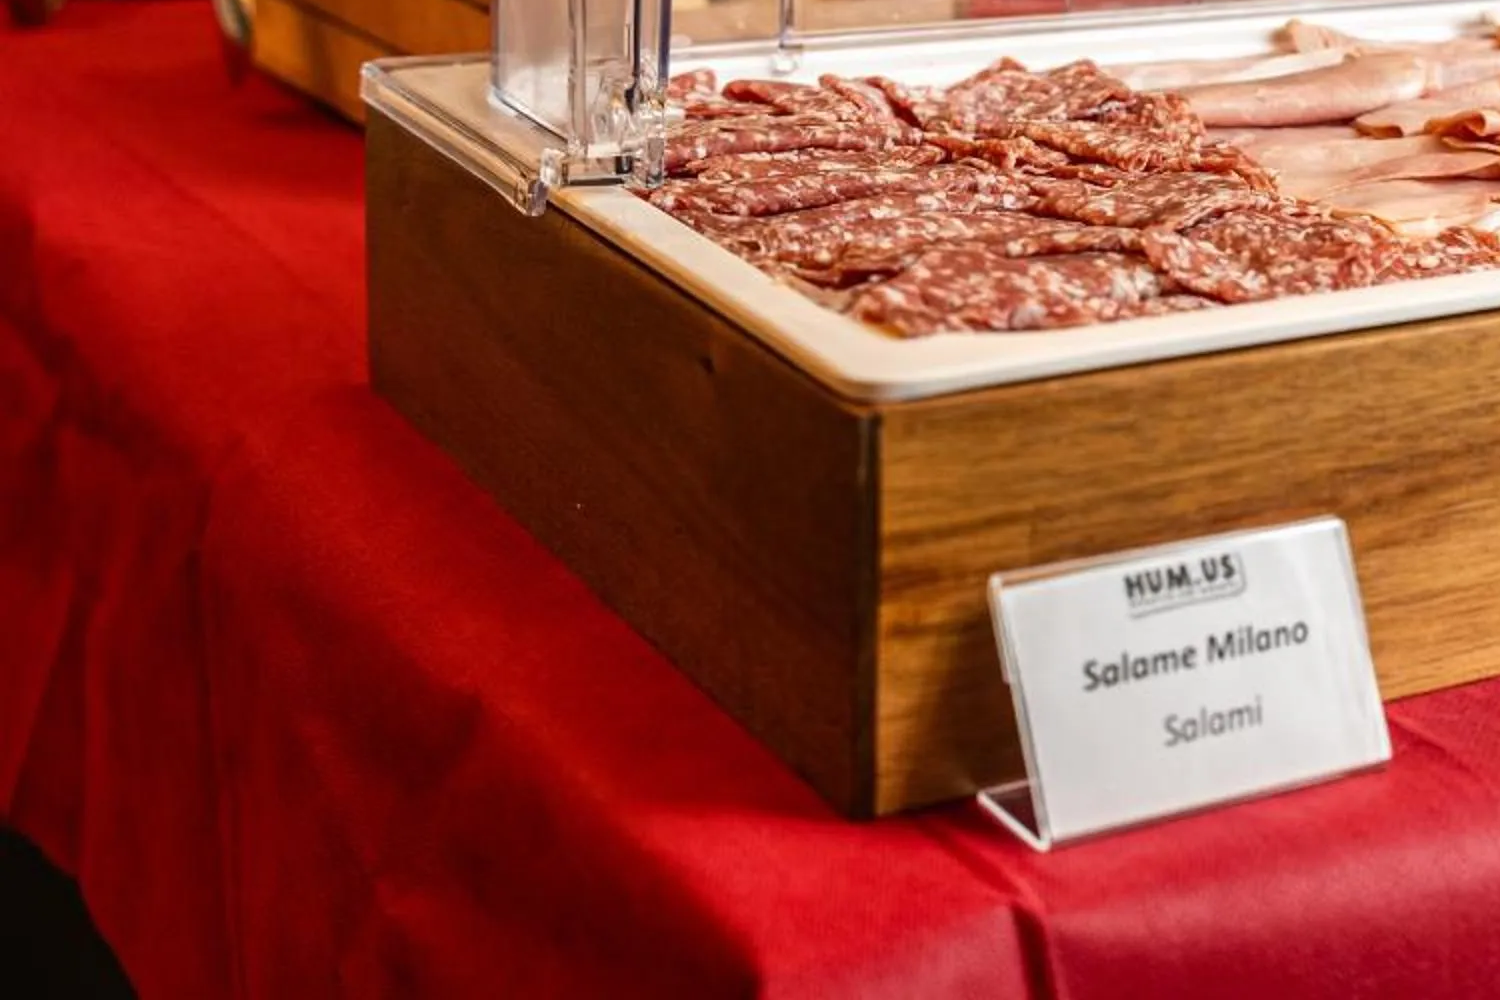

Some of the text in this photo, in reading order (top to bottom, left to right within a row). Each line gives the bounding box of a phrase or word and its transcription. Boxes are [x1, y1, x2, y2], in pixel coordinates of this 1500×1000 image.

[1123, 554, 1236, 599] HUM.US
[1083, 621, 1309, 692] Salame Milano
[1164, 695, 1264, 748] Salami
